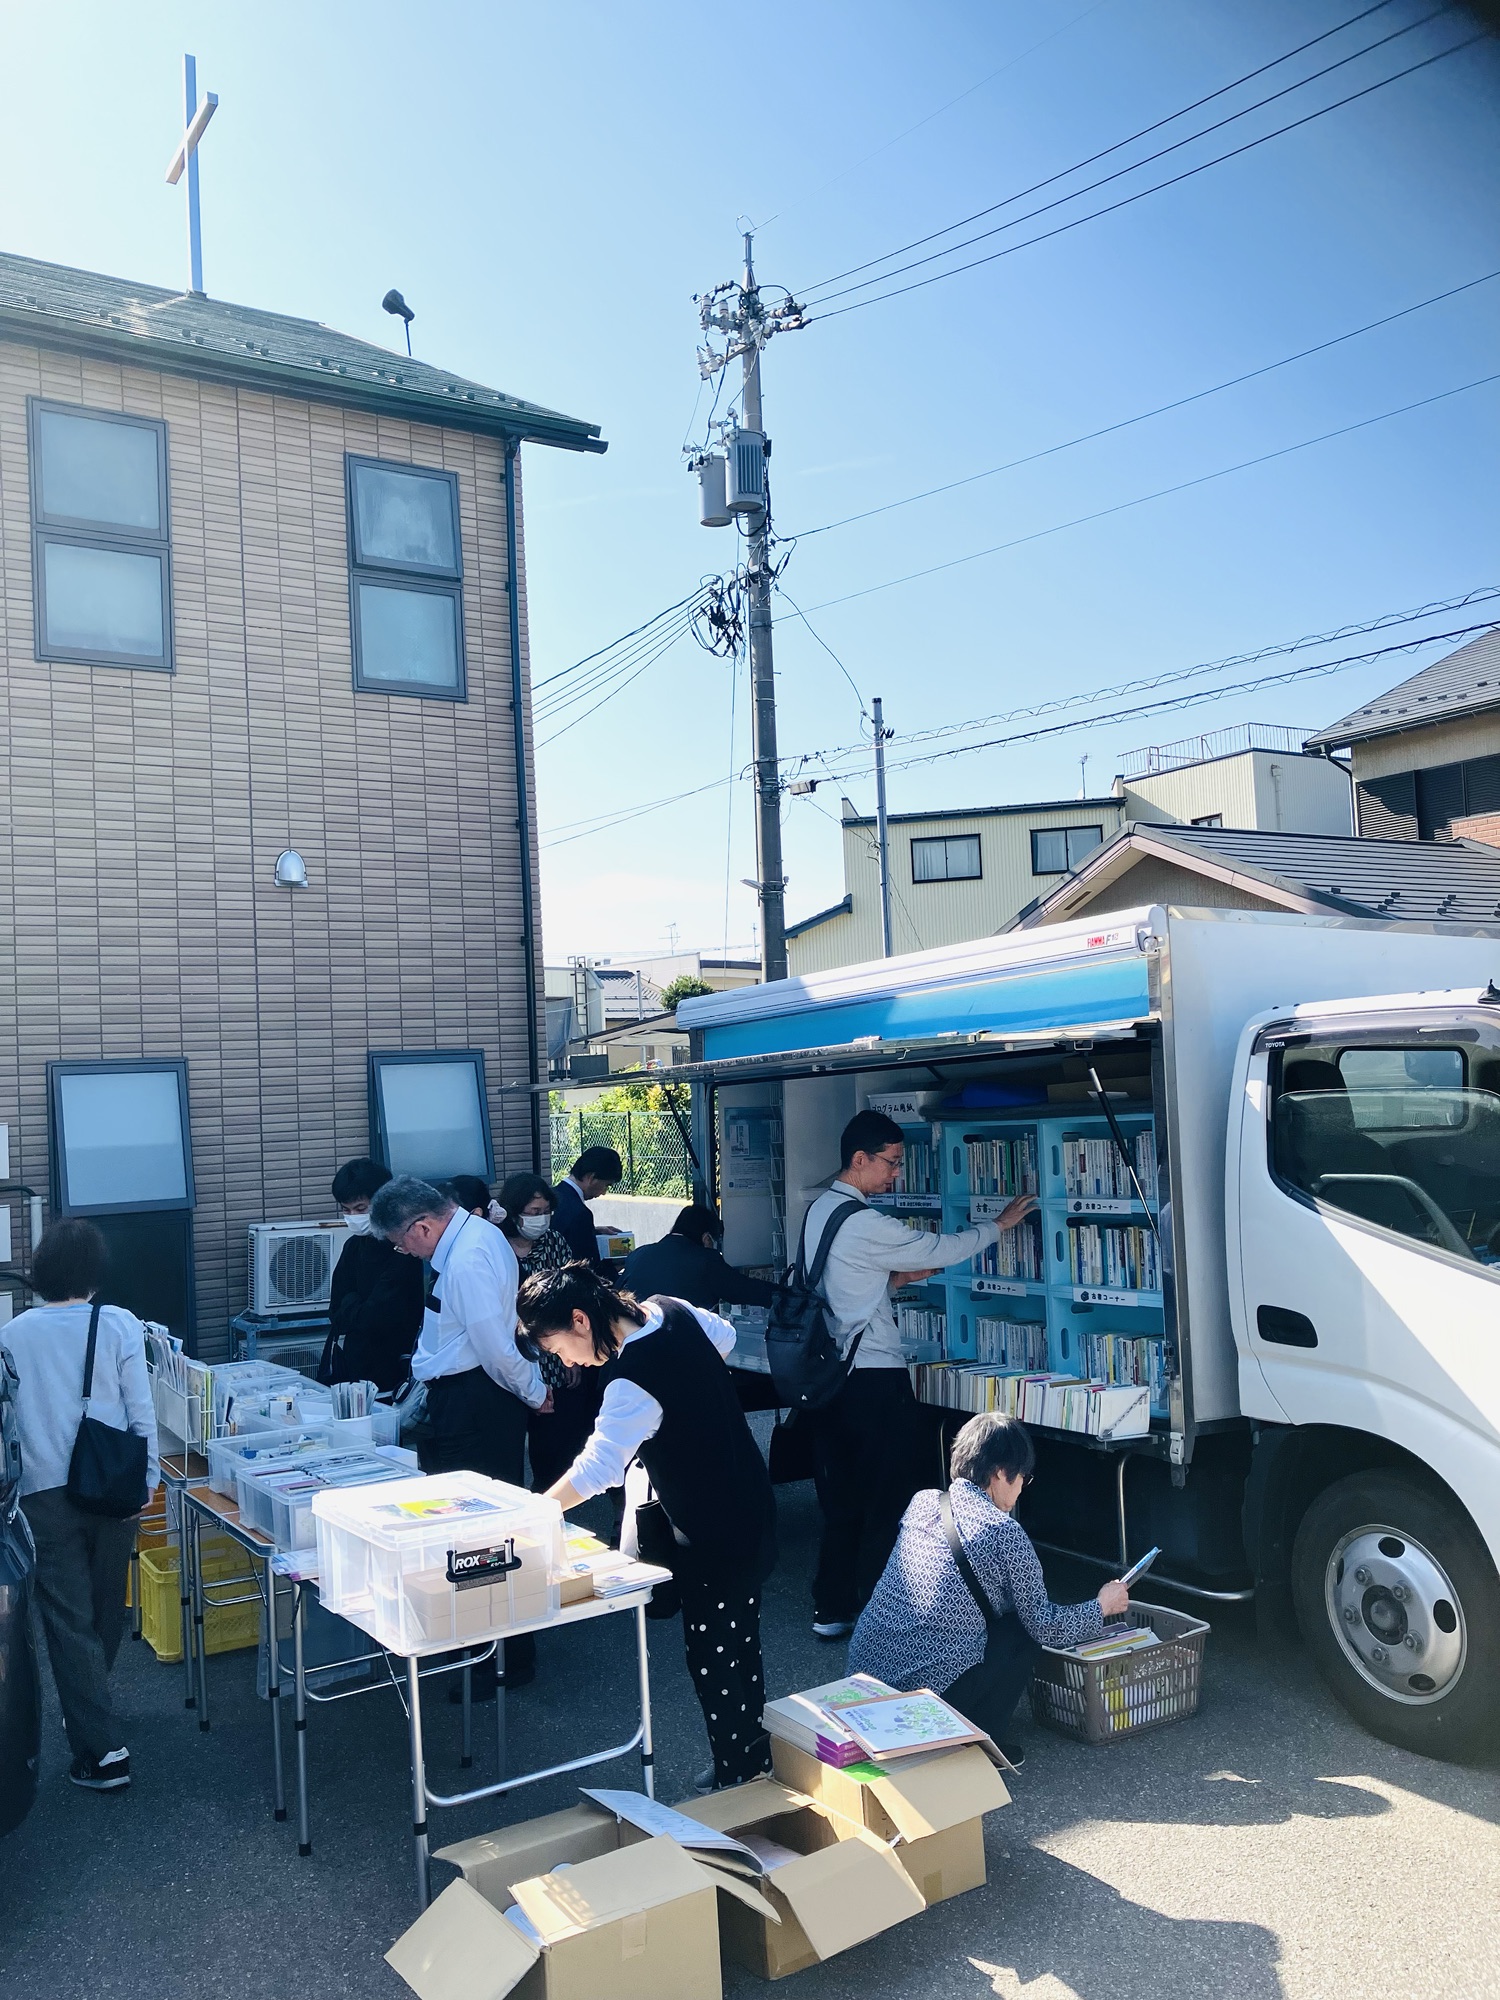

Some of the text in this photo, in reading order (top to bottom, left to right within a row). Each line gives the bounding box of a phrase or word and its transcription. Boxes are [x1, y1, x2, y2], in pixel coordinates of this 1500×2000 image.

[1085, 1202, 1119, 1210] 古書コーナー
[1091, 1292, 1126, 1302] 古書コーナー
[455, 1555, 480, 1570] ROX
